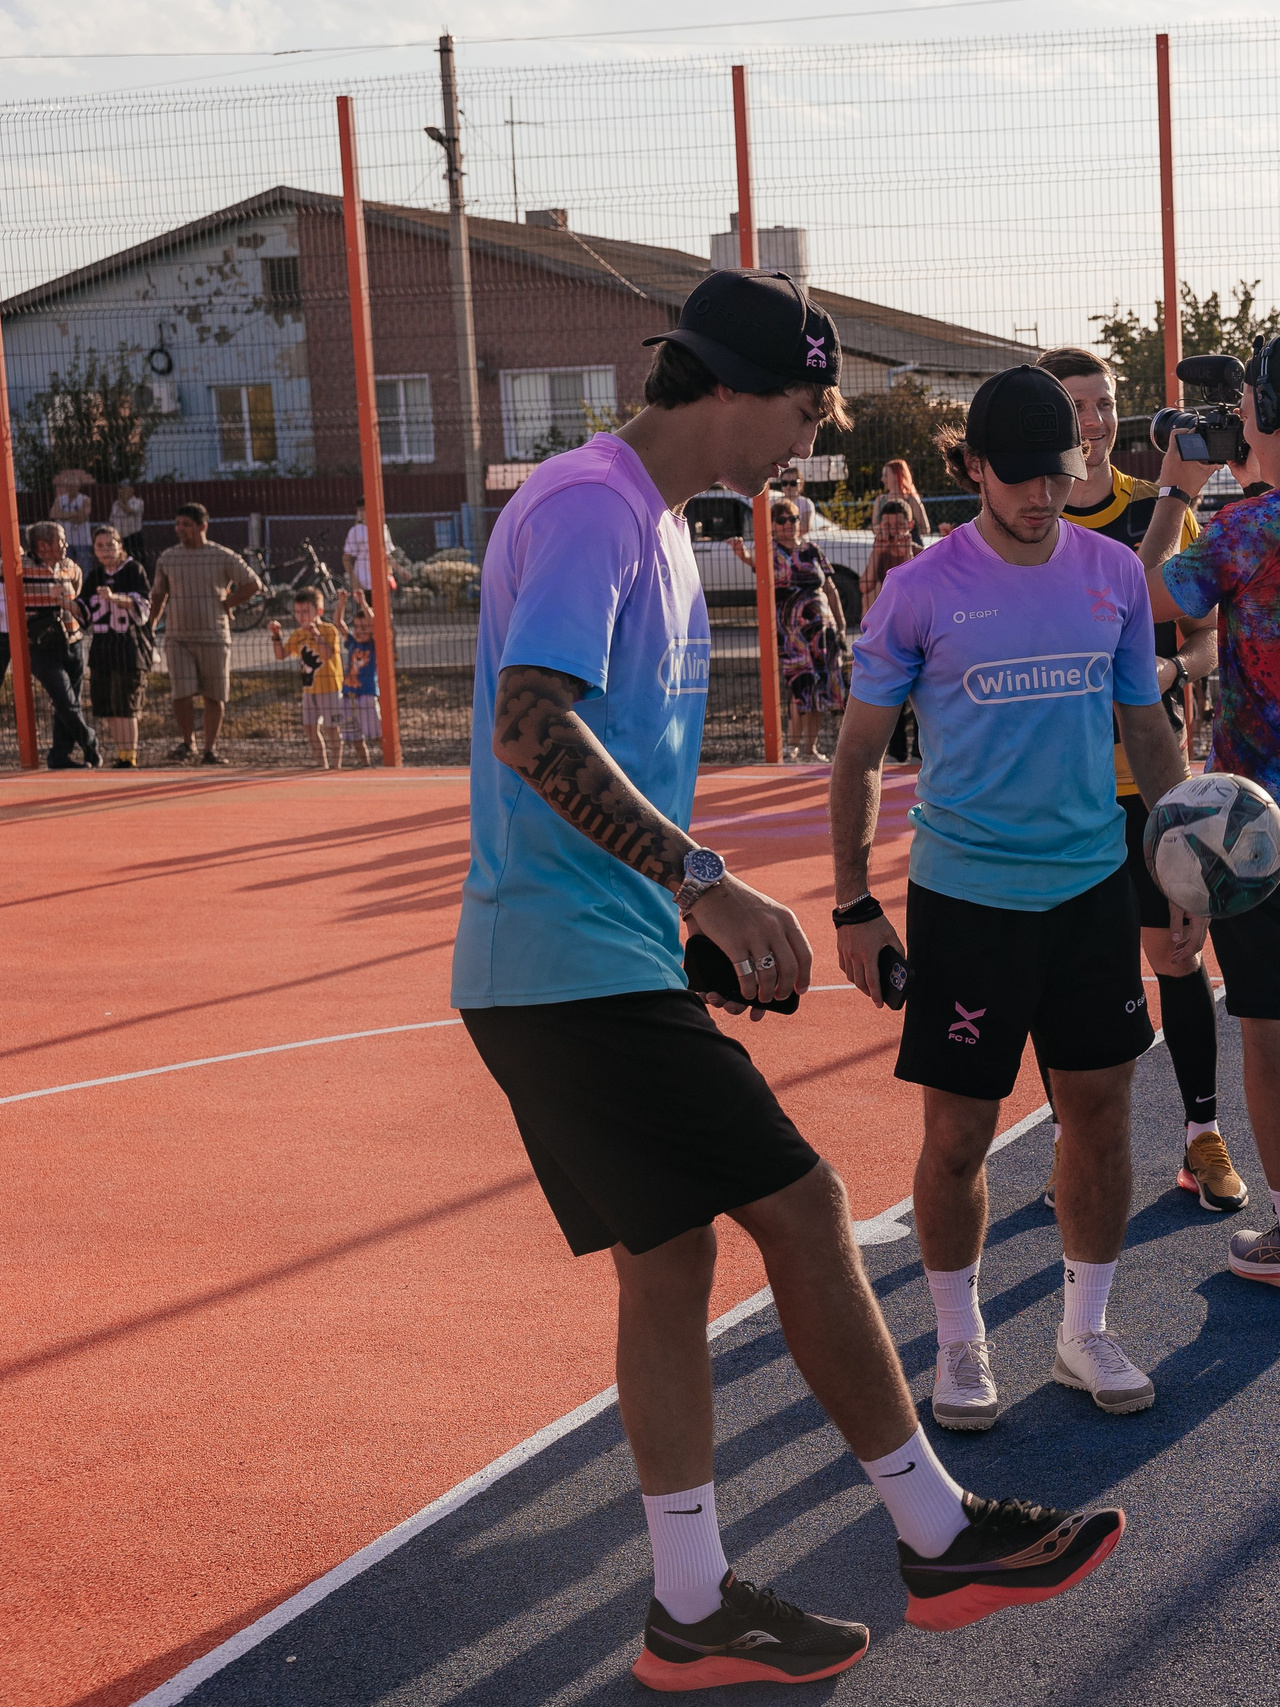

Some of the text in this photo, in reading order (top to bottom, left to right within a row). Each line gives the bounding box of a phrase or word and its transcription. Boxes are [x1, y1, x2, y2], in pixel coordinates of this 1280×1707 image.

[806, 359, 827, 369] FC 10
[970, 609, 999, 620] EQPT
[977, 665, 1082, 694] Winline
[948, 1033, 977, 1045] FC 10
